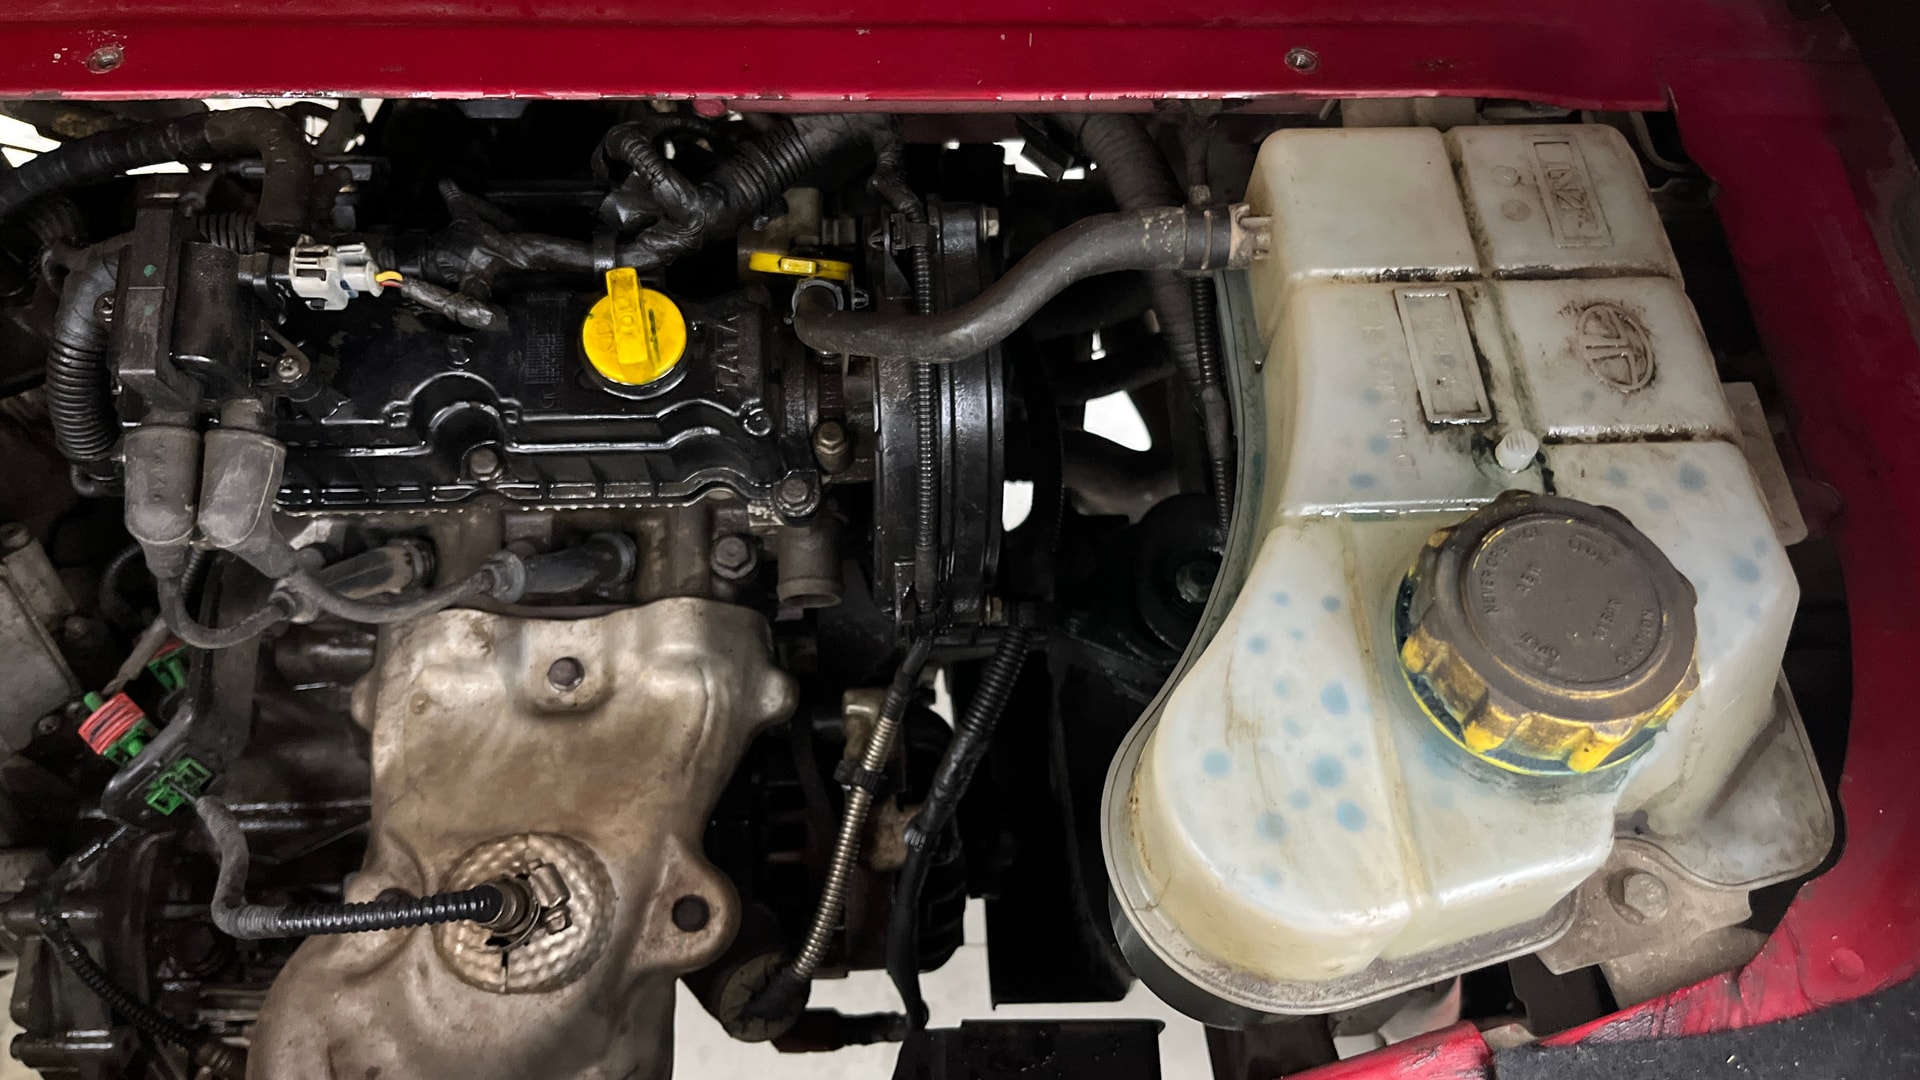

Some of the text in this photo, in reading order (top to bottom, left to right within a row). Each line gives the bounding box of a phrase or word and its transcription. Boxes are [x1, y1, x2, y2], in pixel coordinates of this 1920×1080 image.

[714, 314, 742, 393] TATA
[1486, 538, 1516, 568] OPEN
[1481, 569, 1498, 614] NEVER
